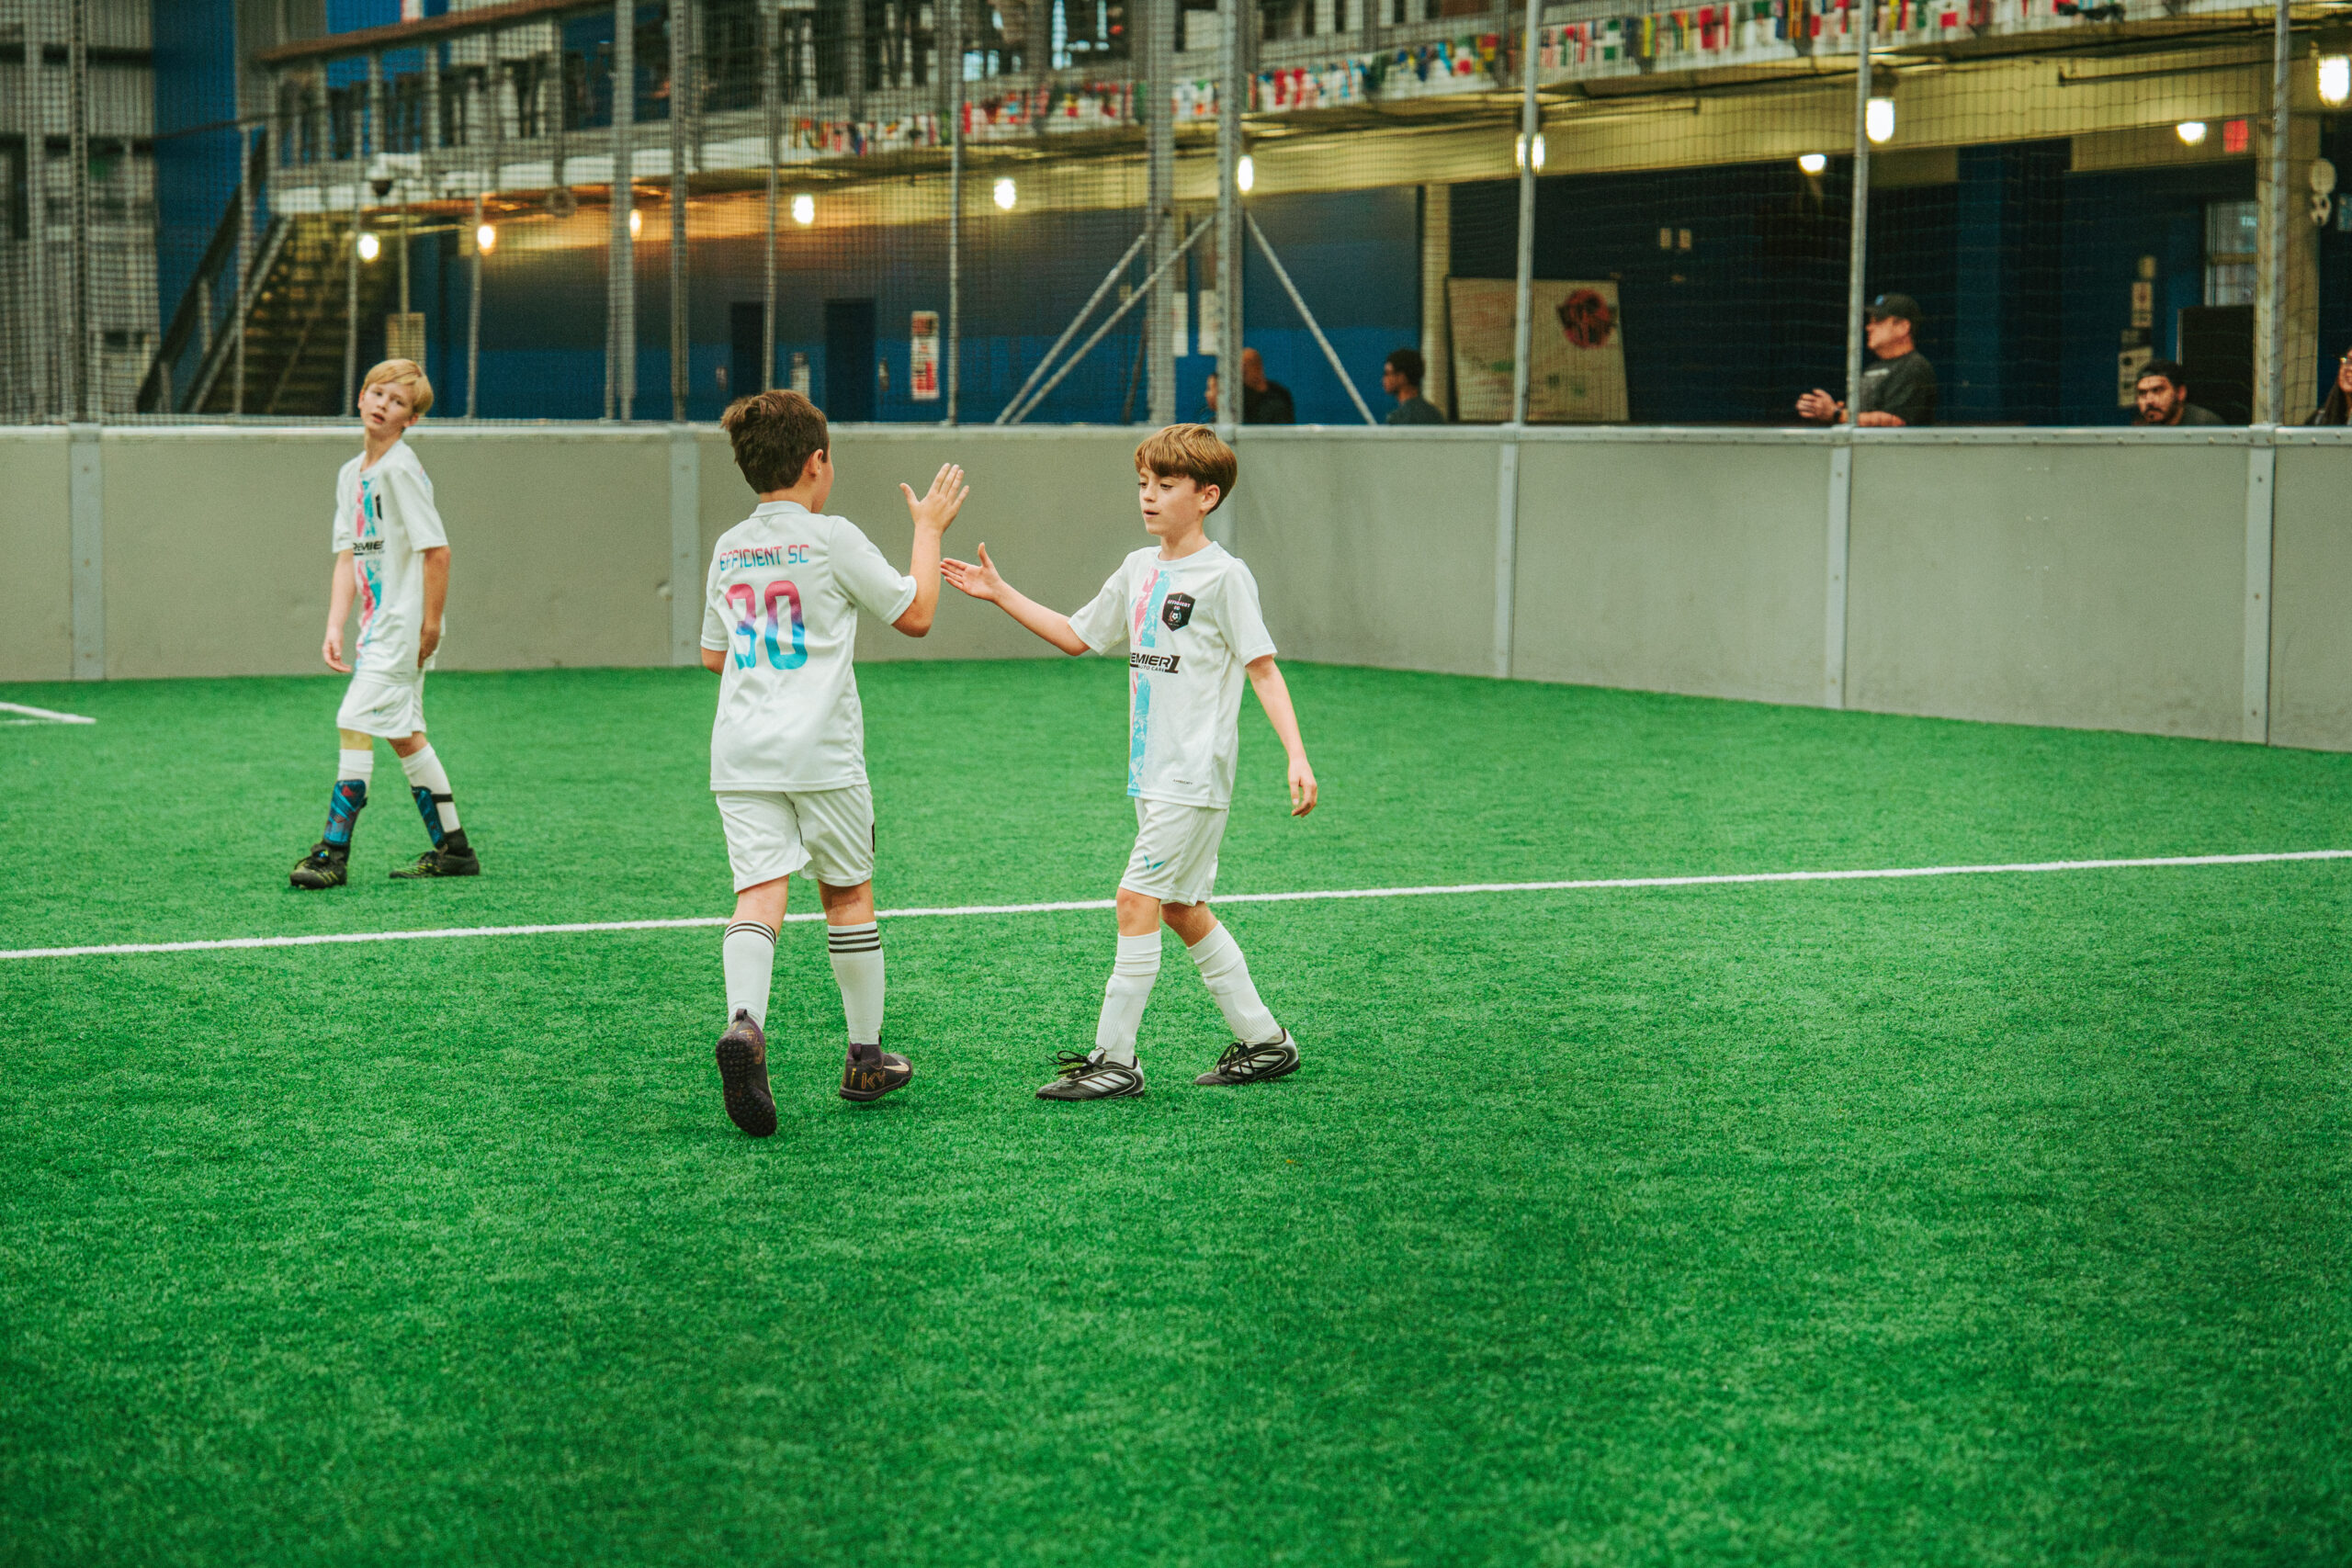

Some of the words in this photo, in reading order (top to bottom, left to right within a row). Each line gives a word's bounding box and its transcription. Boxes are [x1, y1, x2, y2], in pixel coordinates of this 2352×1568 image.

[719, 546, 783, 571] EFFICIENT
[787, 544, 809, 564] SC
[1130, 652, 1181, 673] EMIER1
